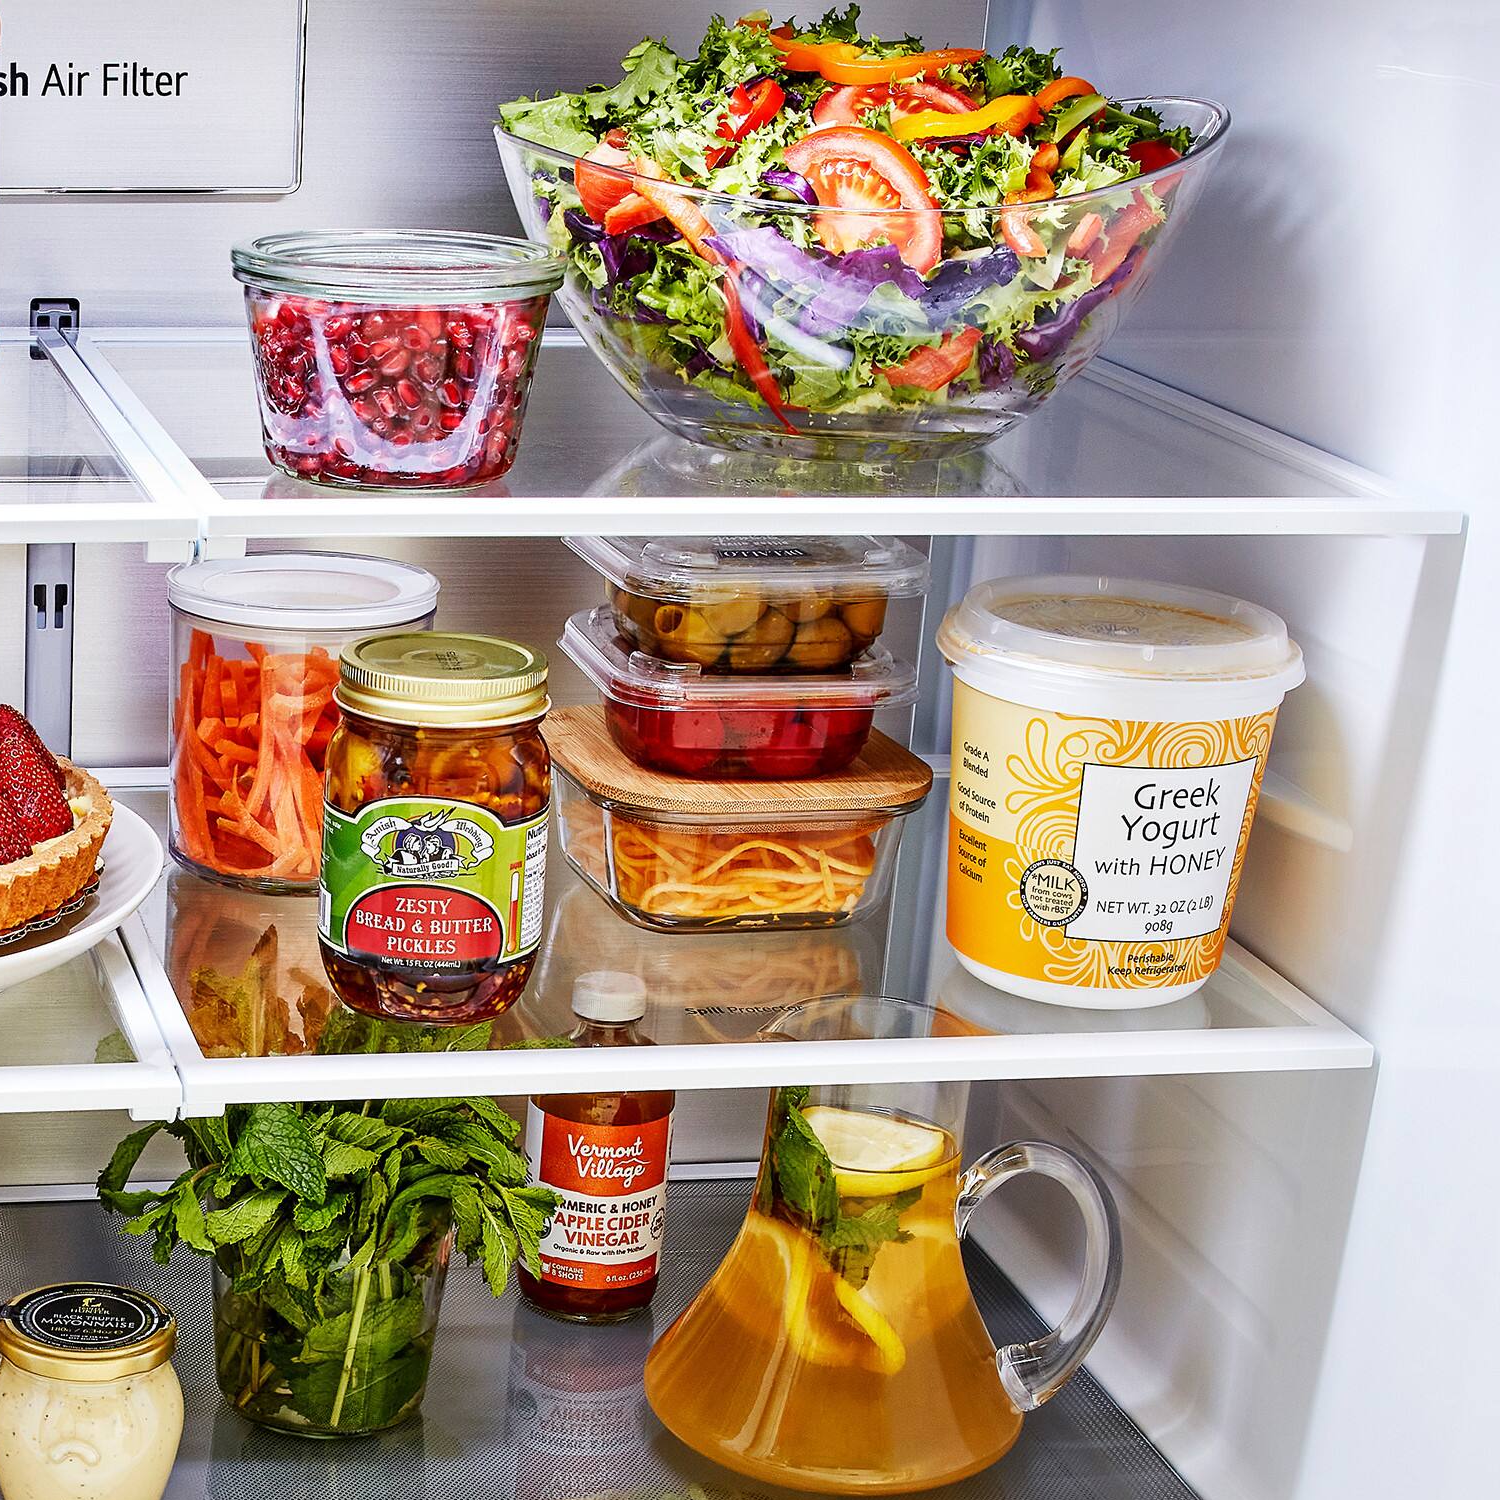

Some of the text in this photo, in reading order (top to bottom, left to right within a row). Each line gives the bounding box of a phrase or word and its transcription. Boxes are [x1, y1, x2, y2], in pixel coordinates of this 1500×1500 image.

[41, 63, 91, 97] Air
[102, 63, 189, 98] Filter
[963, 741, 982, 759] Grade
[963, 758, 988, 779] Blended
[957, 781, 996, 810] Good Source
[1134, 777, 1220, 810] Greek
[965, 803, 990, 824] Protein
[365, 818, 397, 842] Amish
[456, 821, 483, 848] Wedding
[1121, 812, 1220, 849] Yogurt
[958, 829, 987, 852] Excellent
[958, 845, 977, 866] Source
[1095, 846, 1226, 875] with HONEY
[396, 861, 454, 875] Naturally Good!
[958, 863, 983, 883] Calcium
[1030, 894, 1073, 907] not treated
[1032, 886, 1073, 900] from cows
[395, 897, 452, 915] ZESTY
[1034, 904, 1071, 915] with rBST
[1096, 901, 1124, 913] NET
[1128, 902, 1151, 914] WT.
[1154, 904, 1166, 916] 32
[1169, 901, 1186, 914] OZ
[355, 909, 492, 935] BREAD & BUTTER
[1145, 920, 1173, 934] 908g
[387, 936, 457, 954] PICKLES
[381, 956, 393, 965] Net
[1127, 953, 1175, 964] Perishable,
[1108, 962, 1188, 976] Keep Refrigerated
[685, 1003, 805, 1016] Spill Protector
[568, 1133, 644, 1158] Vermont
[576, 1155, 646, 1188] Village
[560, 1195, 658, 1214] RMERIC & HONEY
[553, 1212, 650, 1231] APPLE CIDER
[564, 1229, 640, 1247] VINEGAR
[553, 1243, 578, 1255] Organic
[551, 1262, 584, 1274] CONTAINS
[557, 1271, 584, 1281] SHOTS
[40, 1317, 136, 1329] MAYONNAISE
[53, 1313, 82, 1321] BLACK
